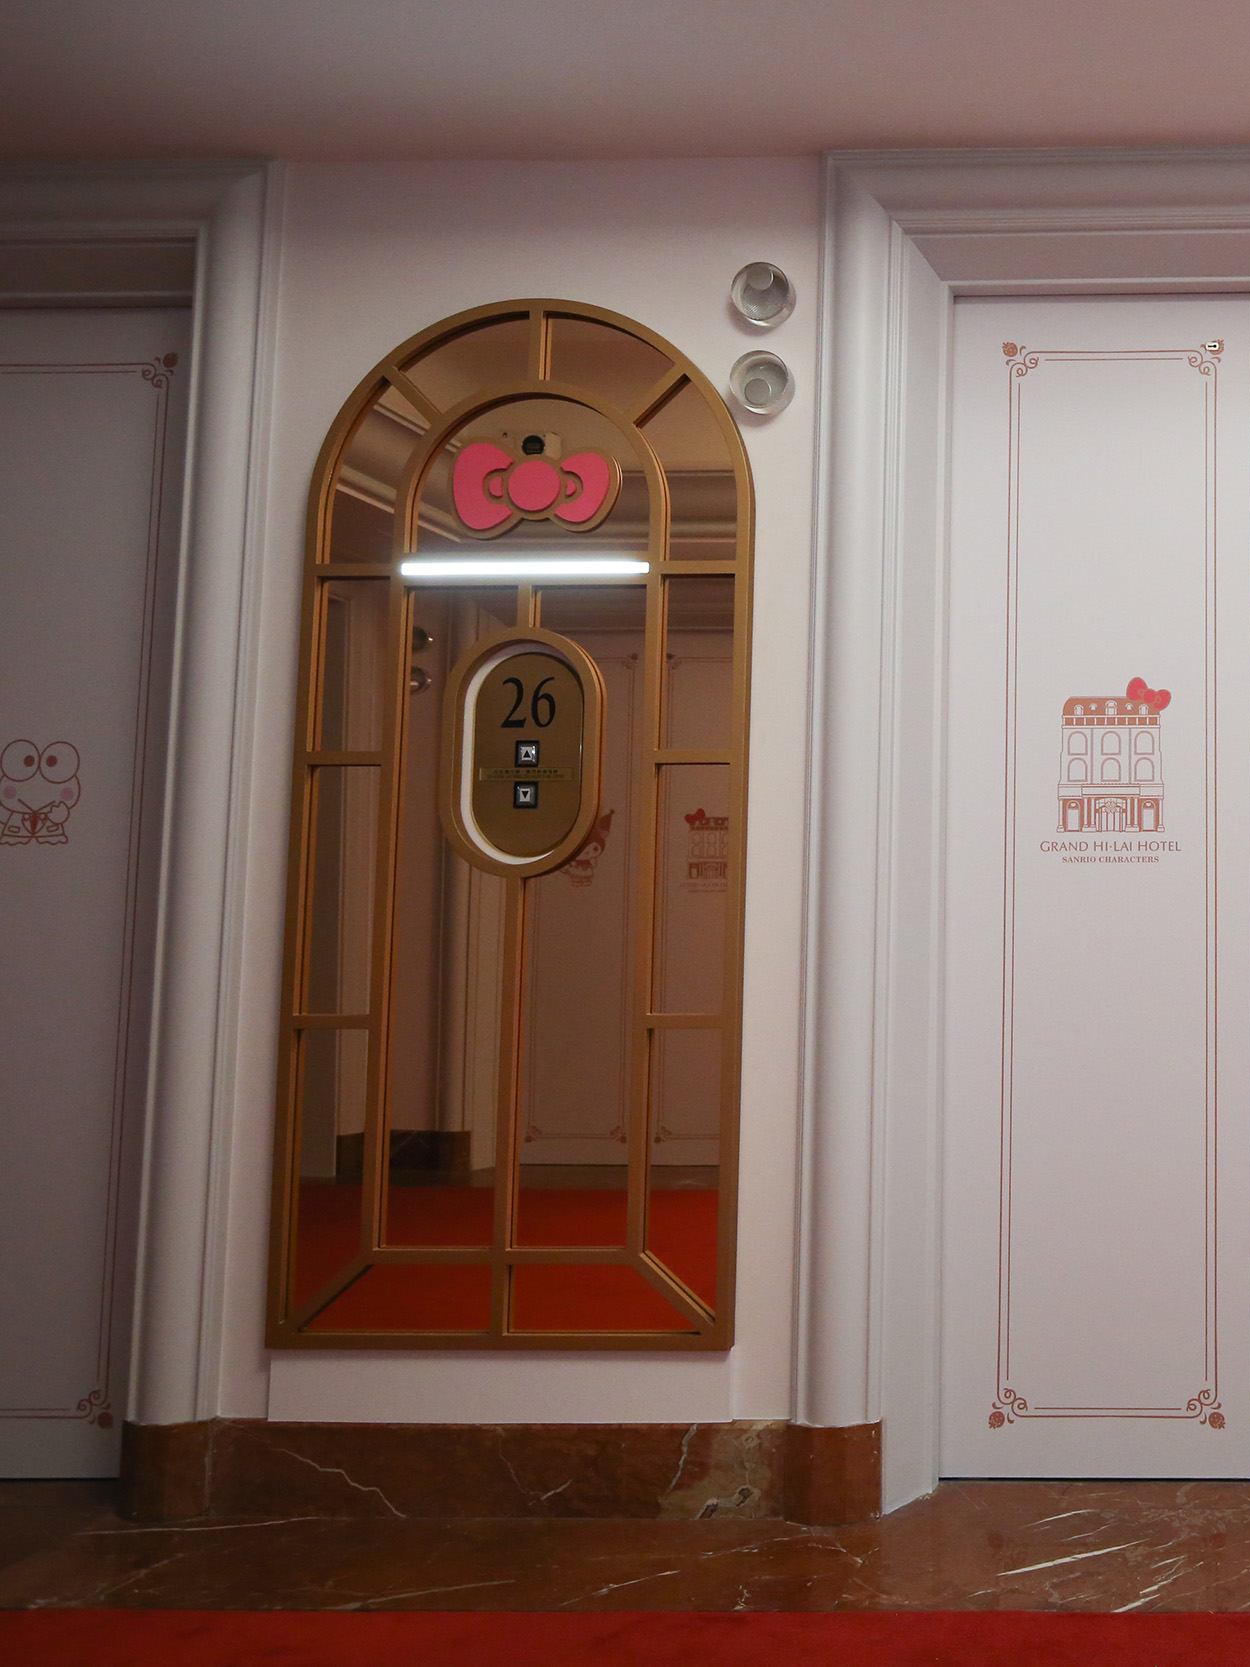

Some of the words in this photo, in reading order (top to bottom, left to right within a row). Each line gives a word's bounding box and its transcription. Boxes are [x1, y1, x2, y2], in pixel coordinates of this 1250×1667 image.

[501, 676, 556, 728] 26
[1040, 841, 1089, 852] GRAND
[1138, 840, 1182, 852] HOTEL
[1062, 856, 1096, 864] SANRIO
[1098, 856, 1160, 864] CHARACTERS
